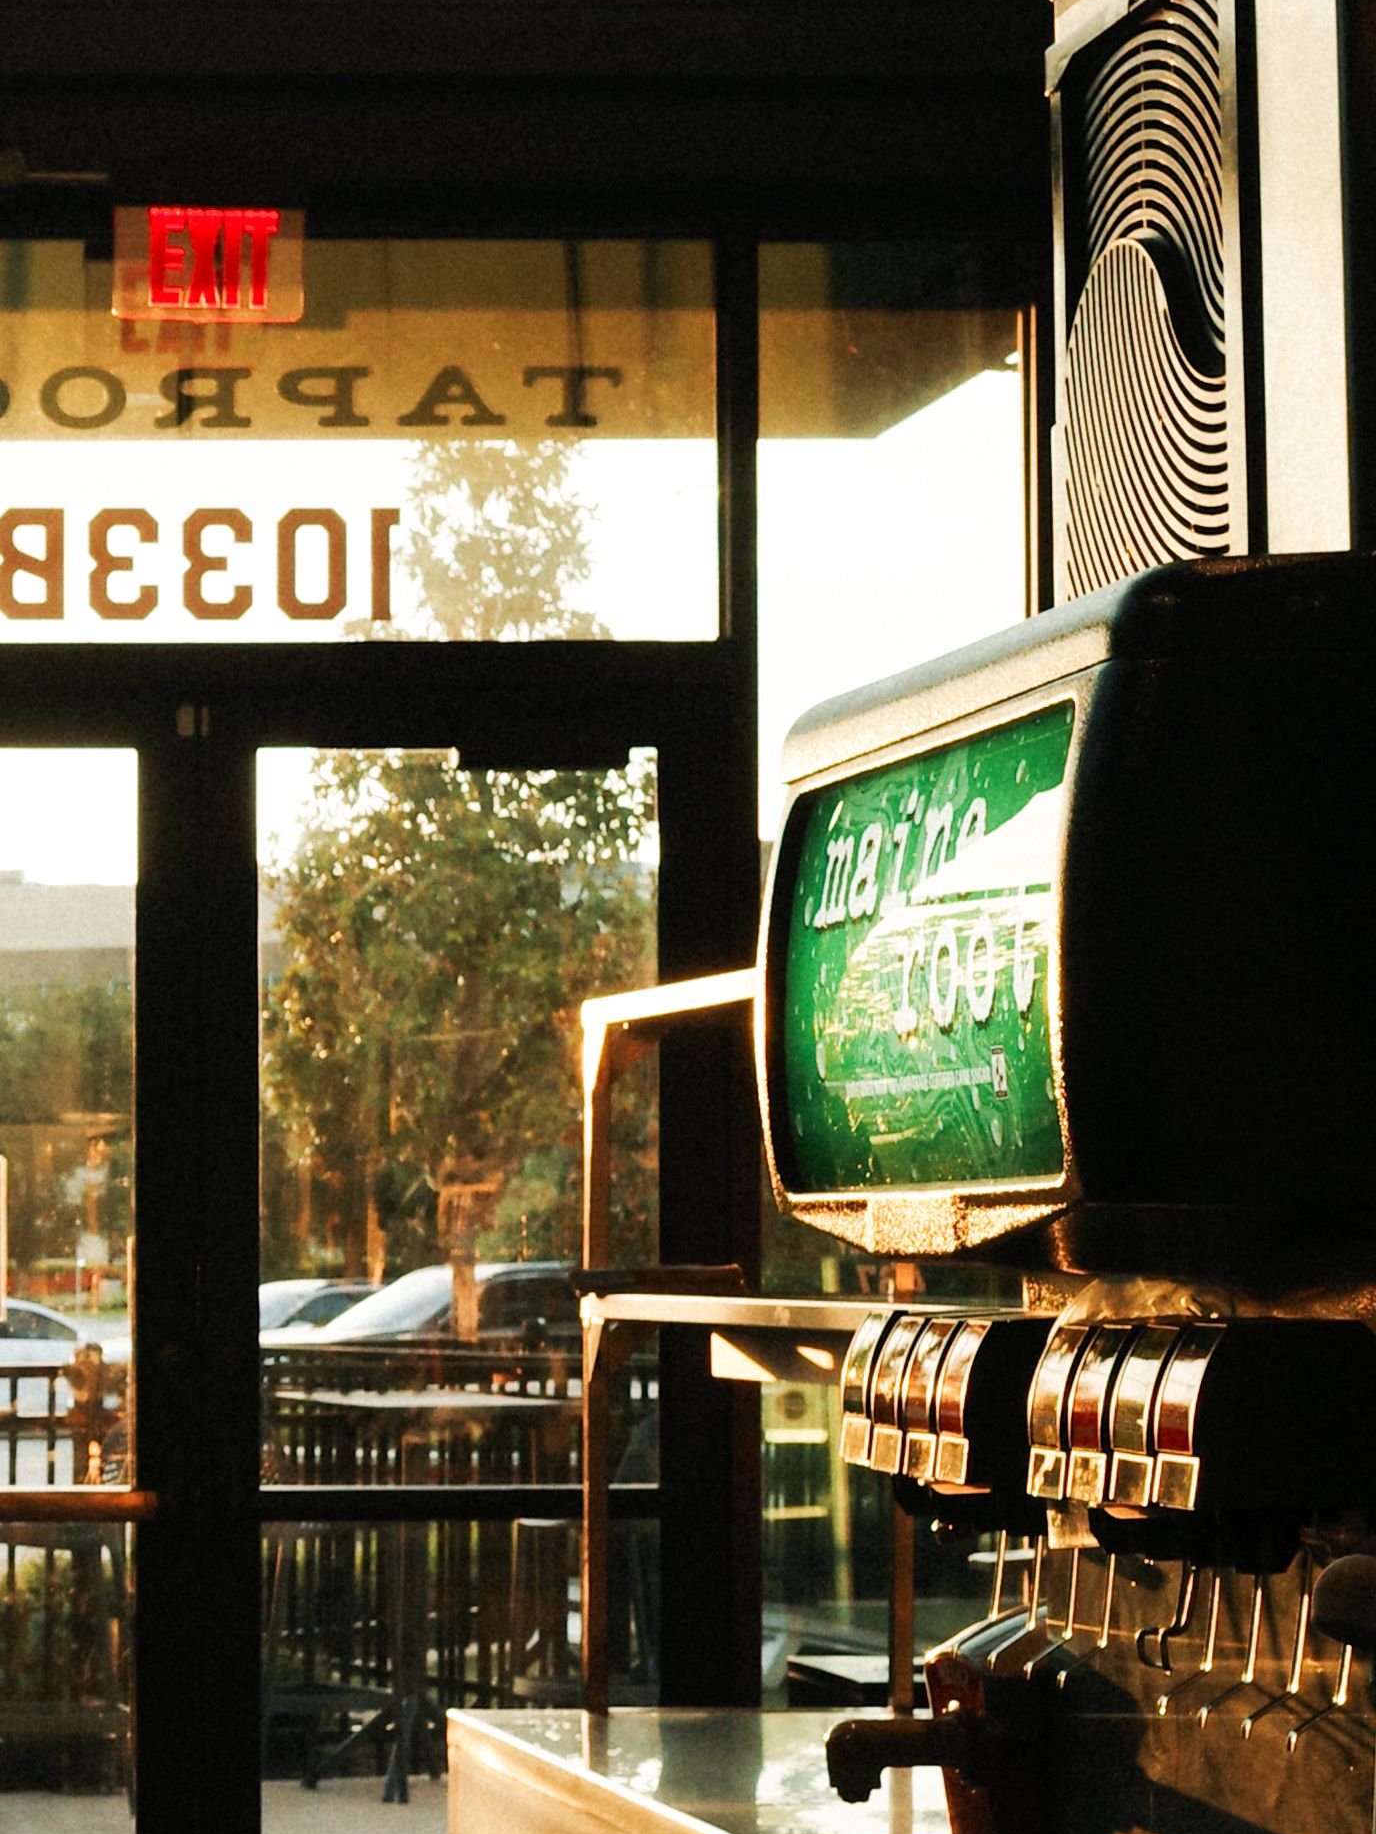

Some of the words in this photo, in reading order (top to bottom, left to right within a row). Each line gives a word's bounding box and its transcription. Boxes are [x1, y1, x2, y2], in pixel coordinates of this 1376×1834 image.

[149, 205, 280, 309] EXIT
[813, 789, 988, 928] maine
[893, 883, 1040, 1033] root
